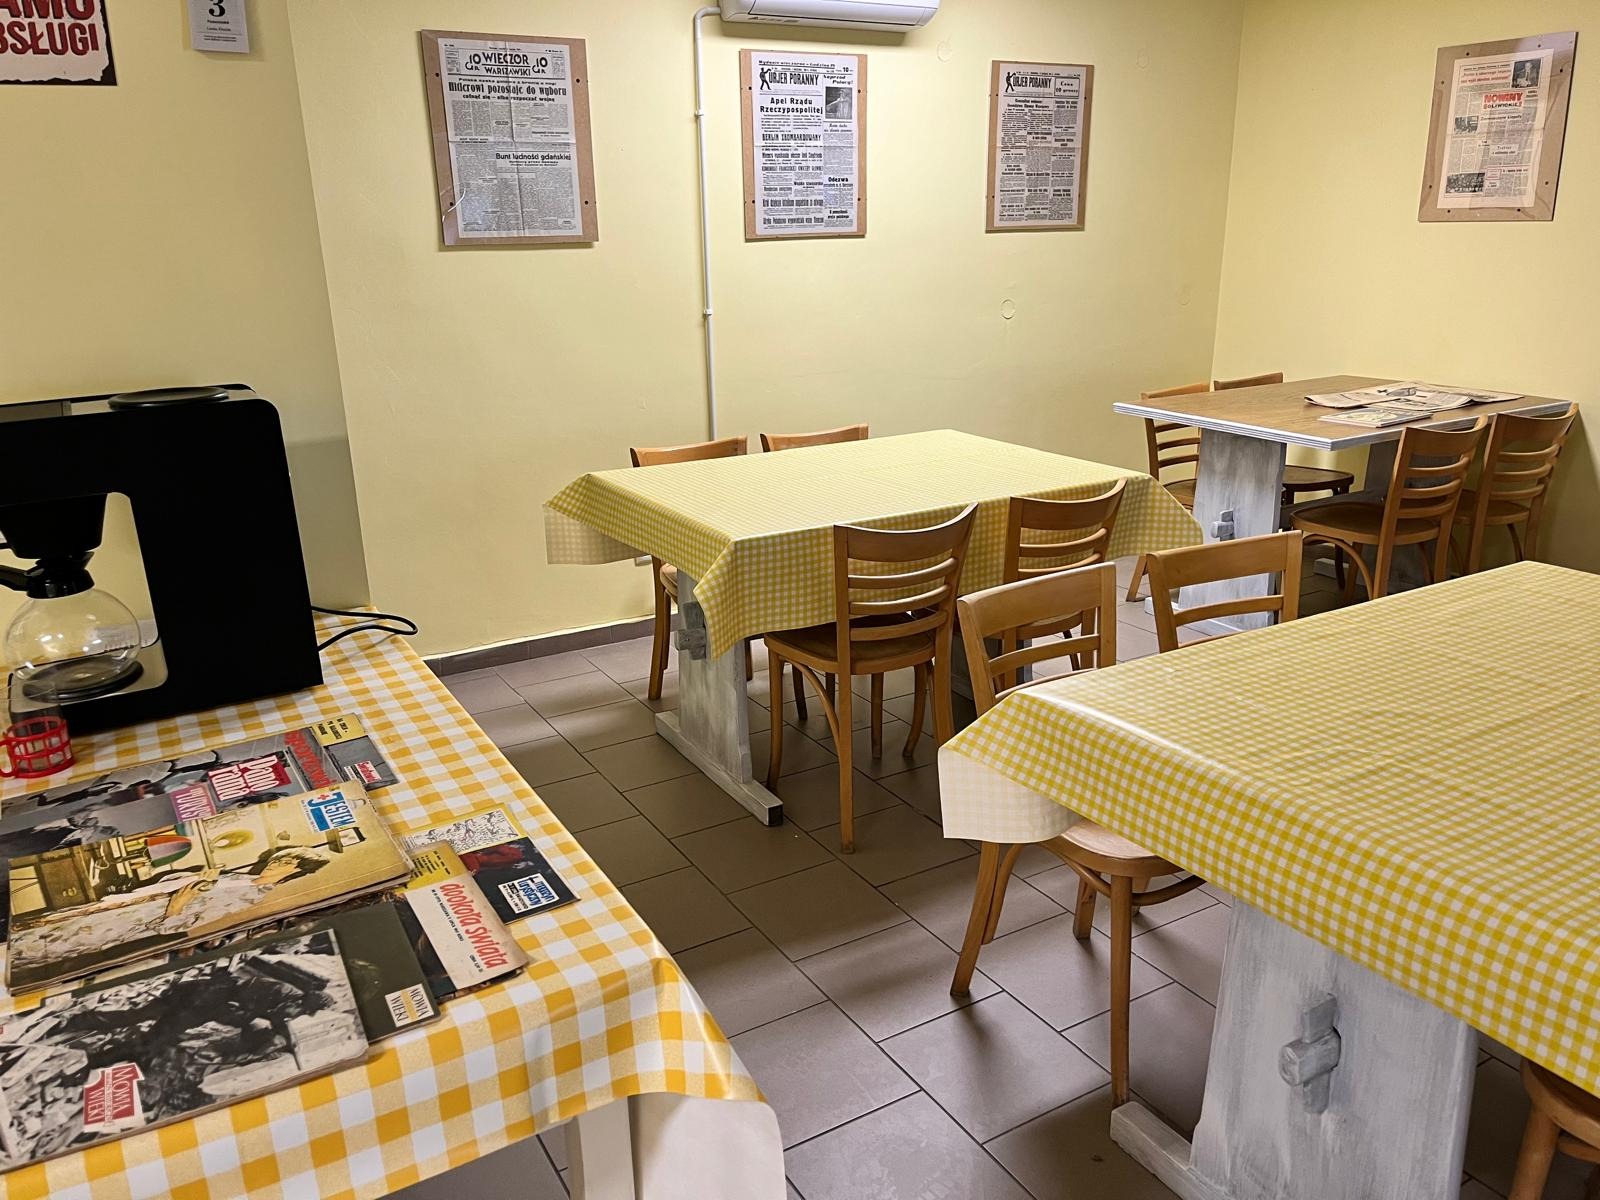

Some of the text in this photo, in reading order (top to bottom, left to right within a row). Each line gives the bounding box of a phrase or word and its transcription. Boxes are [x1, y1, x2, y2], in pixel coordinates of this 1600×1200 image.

[209, 0, 226, 17] 3
[482, 52, 530, 65] WIECZOR
[484, 66, 531, 76] WARSZAWSKI
[789, 73, 820, 86] PORANNY
[526, 85, 536, 95] do
[539, 86, 567, 97] wyboru
[770, 97, 813, 105] Apel Rządu
[760, 105, 823, 115] Rzeczypospolitej
[540, 153, 571, 161] gdańskiej
[239, 755, 280, 792] Pano
[208, 764, 250, 801] rama
[307, 791, 356, 829] JESTEM
[390, 995, 409, 1022] WIEKI
[87, 1086, 105, 1122] WIEKI
